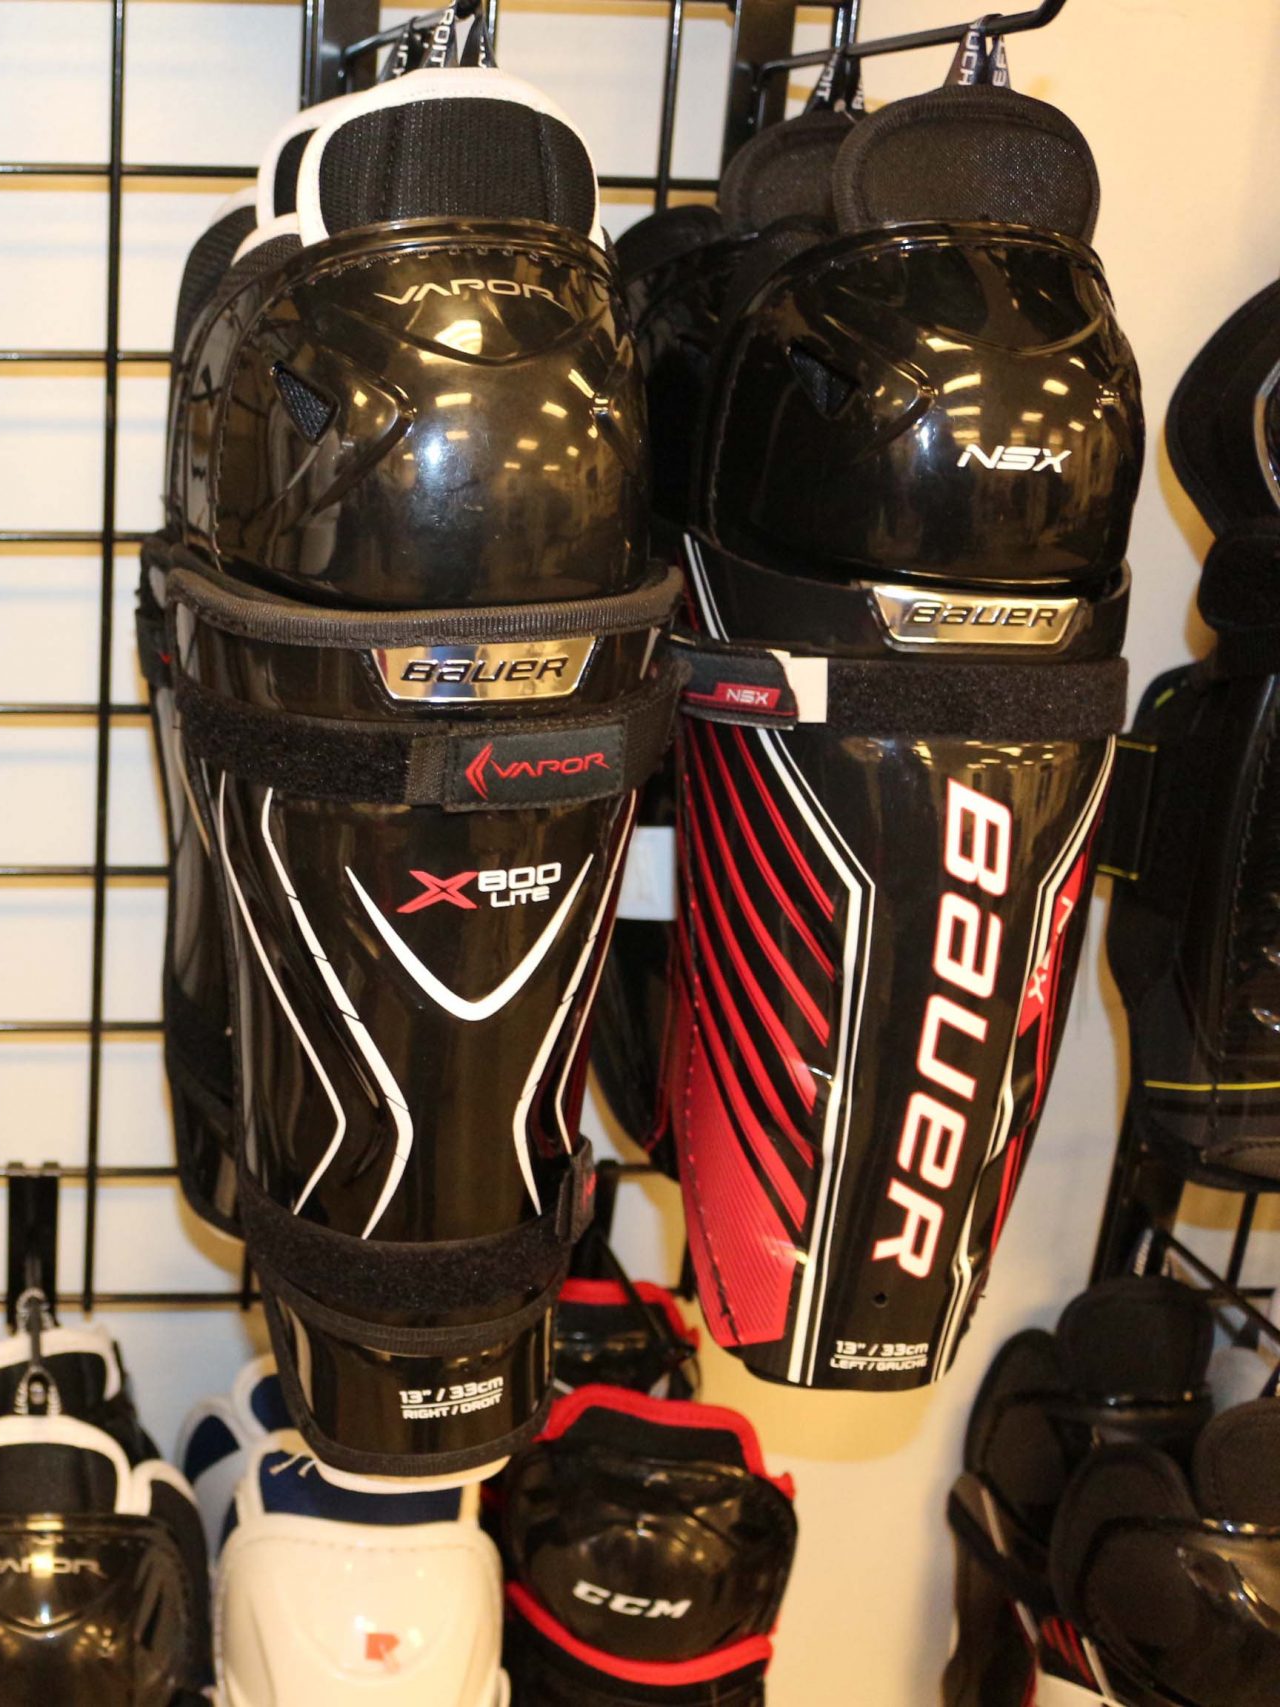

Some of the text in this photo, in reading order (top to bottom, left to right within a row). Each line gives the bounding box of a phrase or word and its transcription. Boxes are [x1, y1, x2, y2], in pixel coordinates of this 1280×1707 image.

[373, 279, 571, 312] VAPOR
[957, 444, 1072, 474] NSX
[726, 688, 769, 705] NSX
[489, 752, 610, 779] VAPOR
[490, 885, 551, 908] LITE
[880, 1342, 930, 1358] 33cm
[829, 1358, 868, 1371] LEFT
[448, 1376, 504, 1400] 33cm
[402, 1406, 450, 1420] RIGHT
[459, 1393, 503, 1414] DROIT
[572, 1579, 693, 1619] CCM
